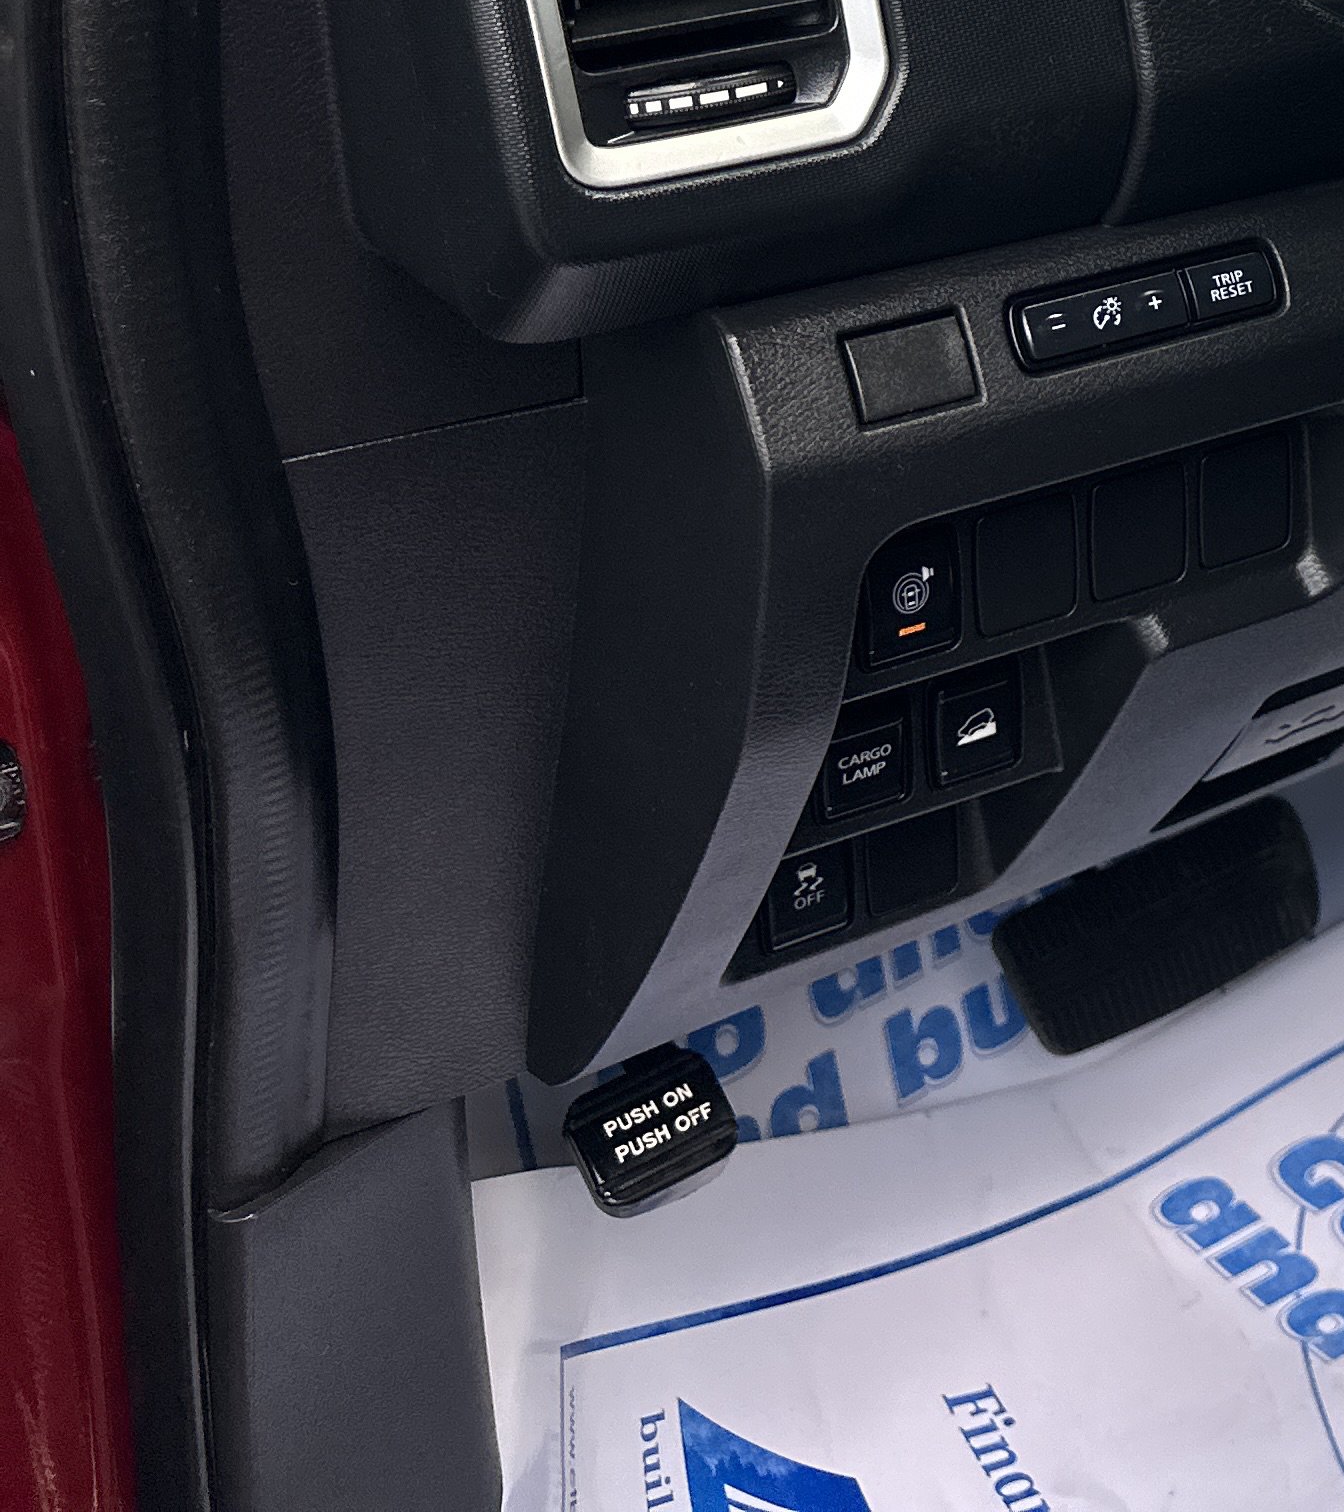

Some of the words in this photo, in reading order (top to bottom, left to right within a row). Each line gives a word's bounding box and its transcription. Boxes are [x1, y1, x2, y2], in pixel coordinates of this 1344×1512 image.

[1210, 280, 1254, 303] RESET
[1212, 270, 1244, 288] TRIP
[838, 743, 892, 770] CARGO
[842, 761, 886, 786] LAMP
[793, 889, 826, 911] OFF
[603, 1100, 660, 1139] PUSH
[663, 1083, 694, 1108] ON
[614, 1123, 672, 1165] PUSH
[674, 1102, 712, 1132] OFF
